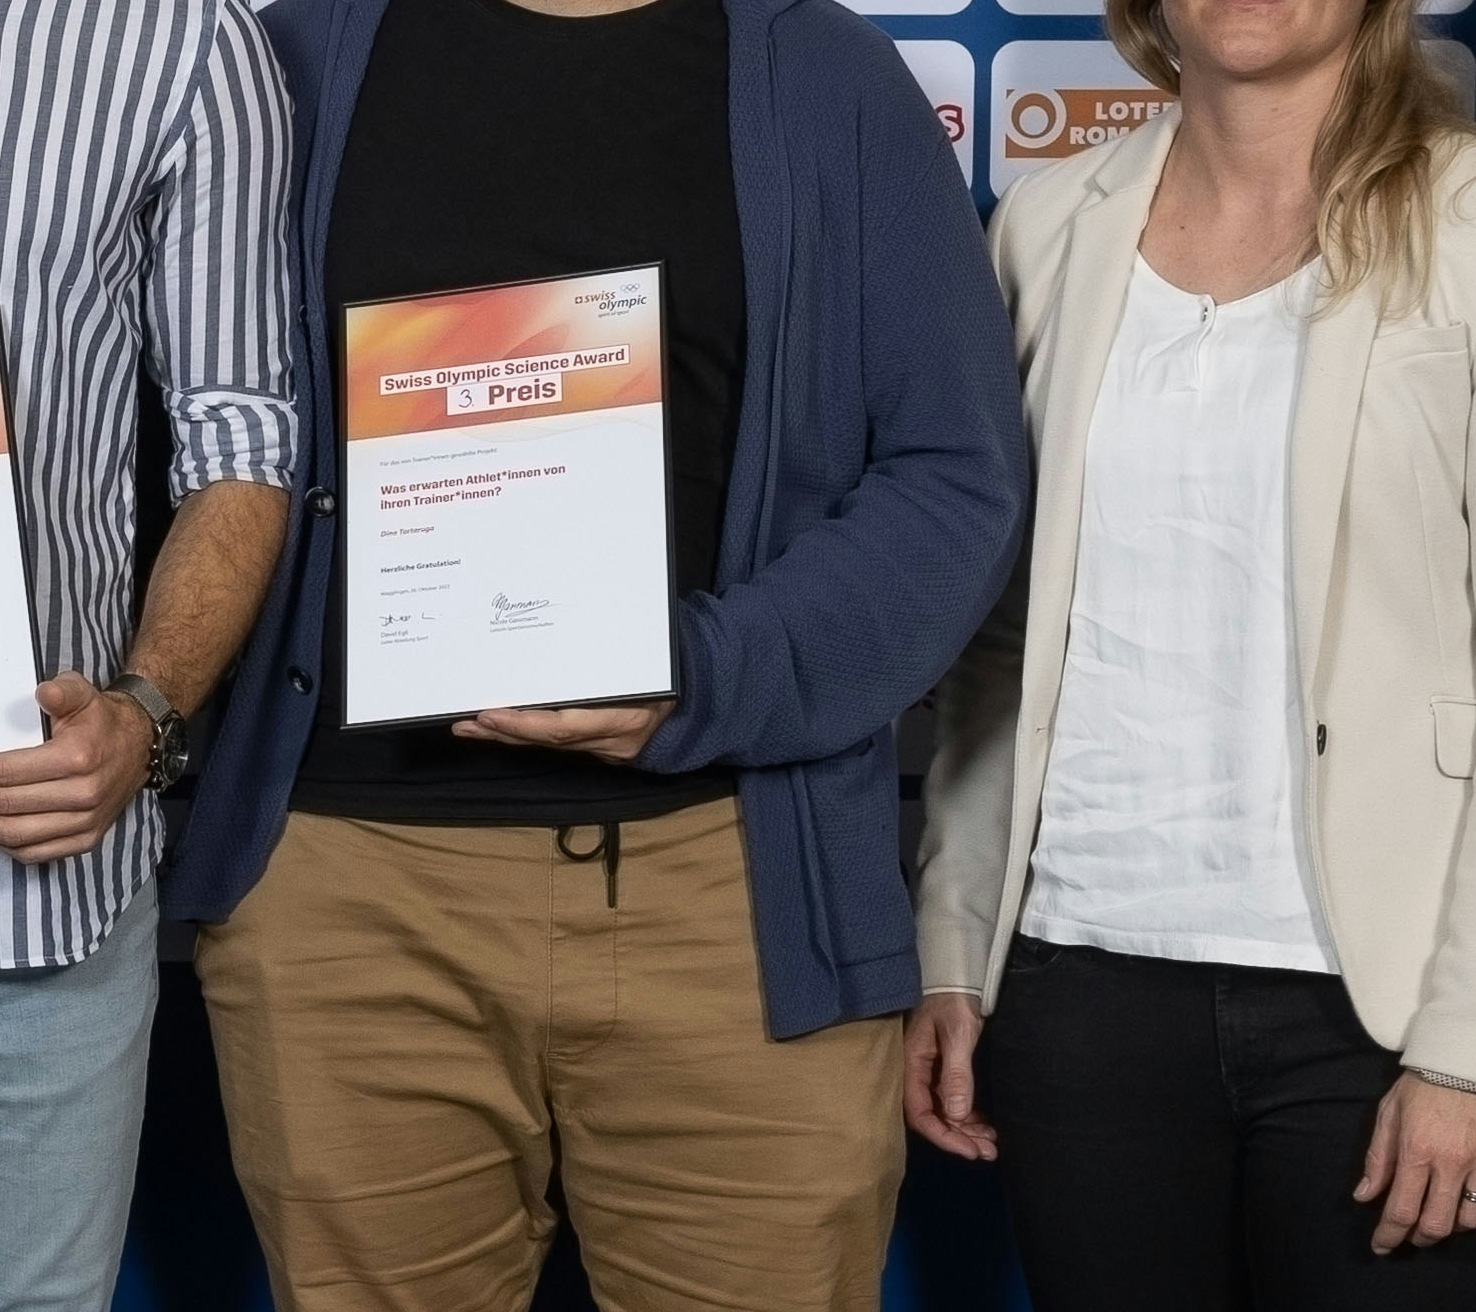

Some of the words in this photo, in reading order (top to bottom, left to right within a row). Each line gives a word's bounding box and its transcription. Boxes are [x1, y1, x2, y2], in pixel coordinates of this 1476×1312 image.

[584, 291, 616, 303] swiss
[599, 295, 646, 310] olympic
[385, 377, 432, 391] Swiss
[436, 366, 501, 386] Olympic
[504, 357, 569, 375] Science
[573, 349, 624, 367] Award
[489, 379, 556, 404] Preis
[380, 485, 406, 495] Was
[409, 478, 463, 492] erwarten
[543, 466, 566, 476] von
[381, 499, 411, 510] ihren
[380, 564, 415, 573] Herzliche
[416, 559, 461, 570] Gratulation!
